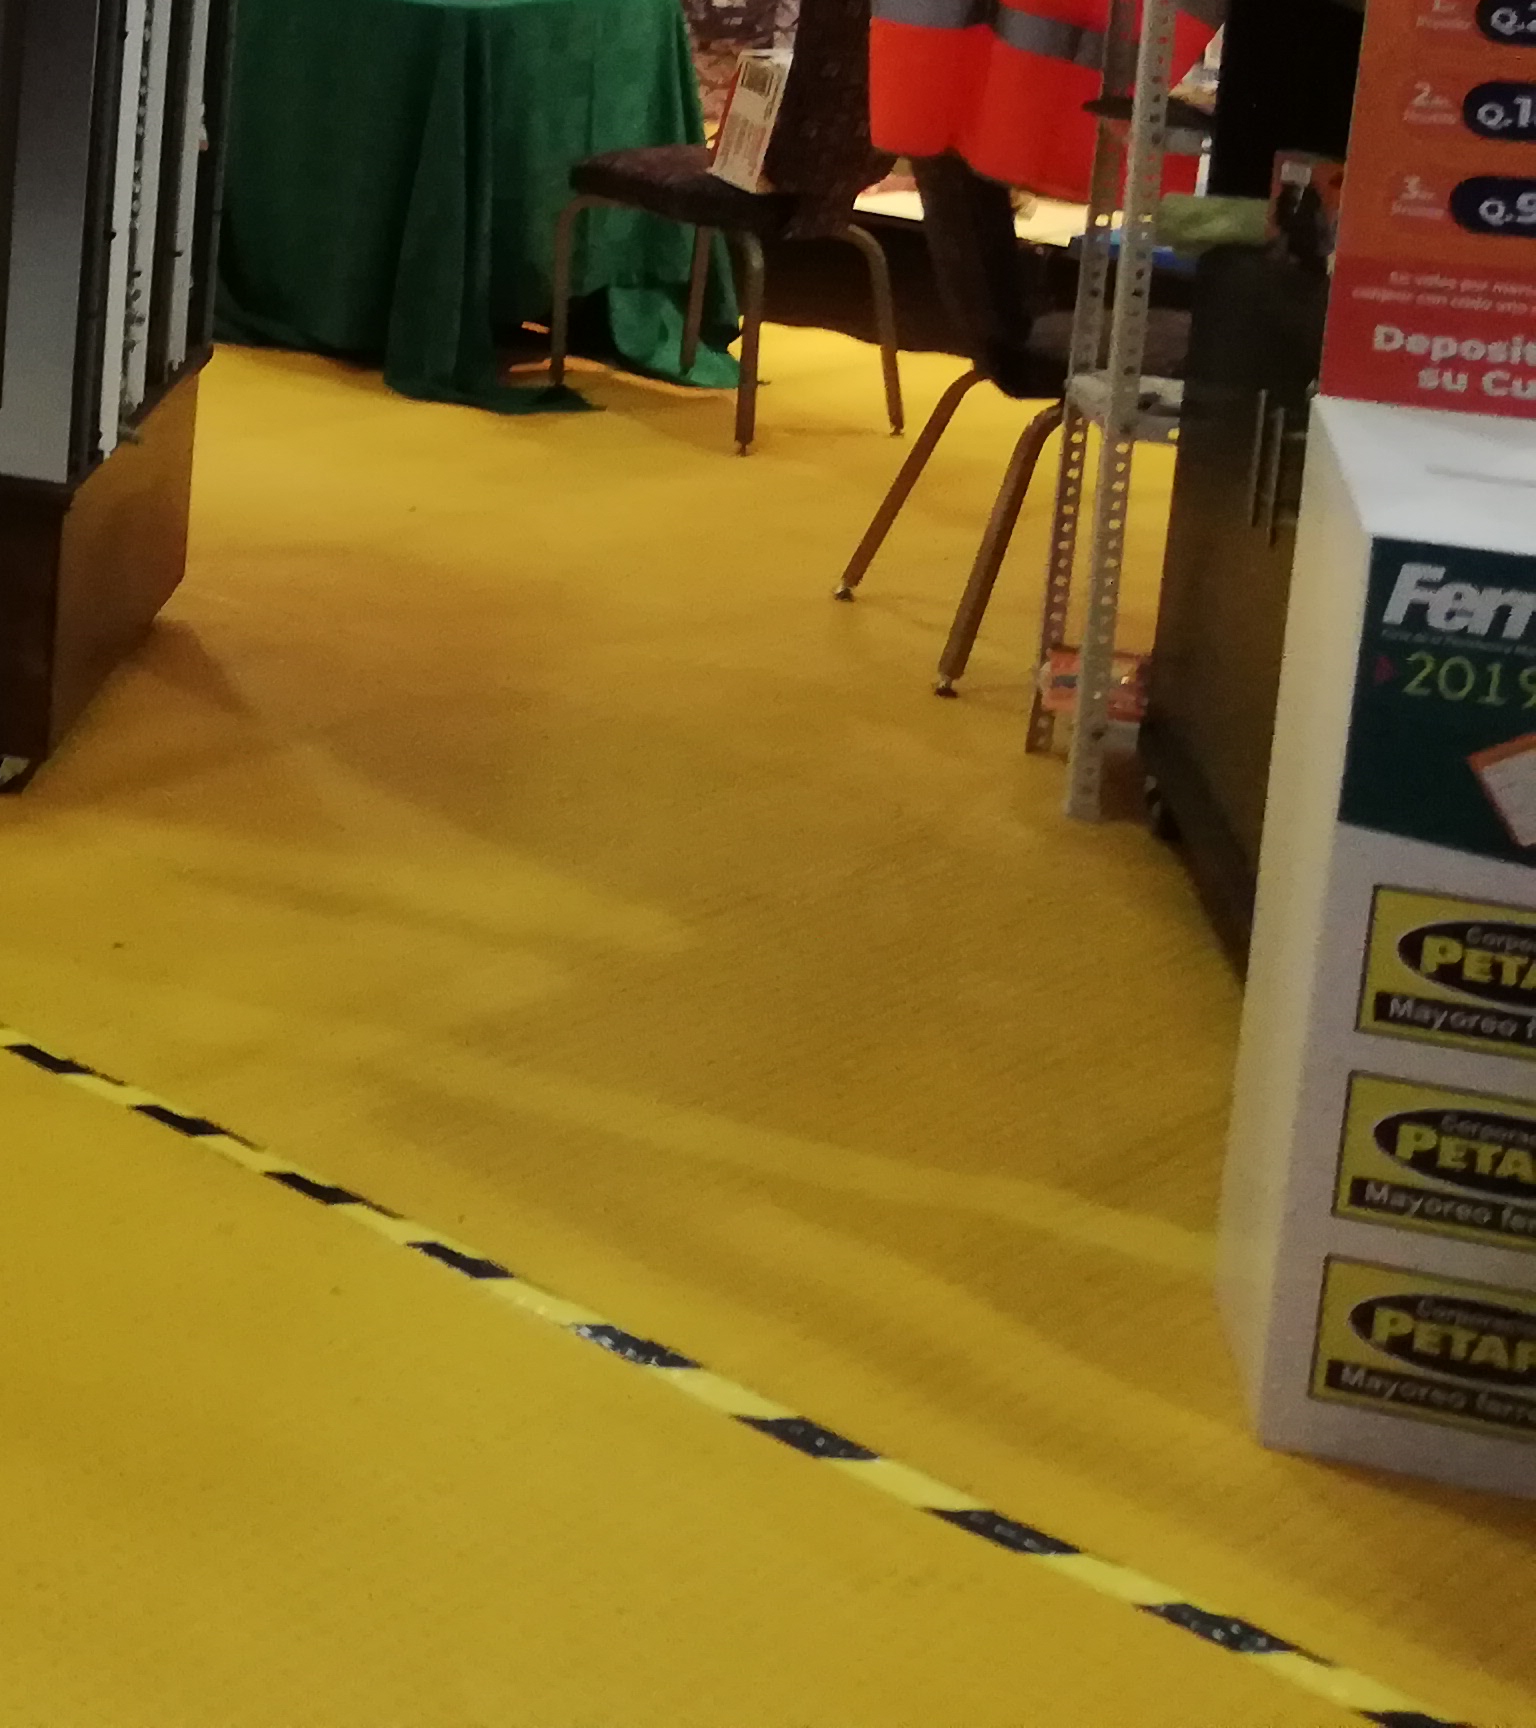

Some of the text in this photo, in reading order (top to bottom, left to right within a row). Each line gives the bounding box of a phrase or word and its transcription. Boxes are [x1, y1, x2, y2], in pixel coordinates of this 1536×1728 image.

[1388, 997, 1519, 1038] Mayoreo
[1365, 1181, 1494, 1225] Mayoreo
[1341, 1365, 1467, 1409] Mayoreo
